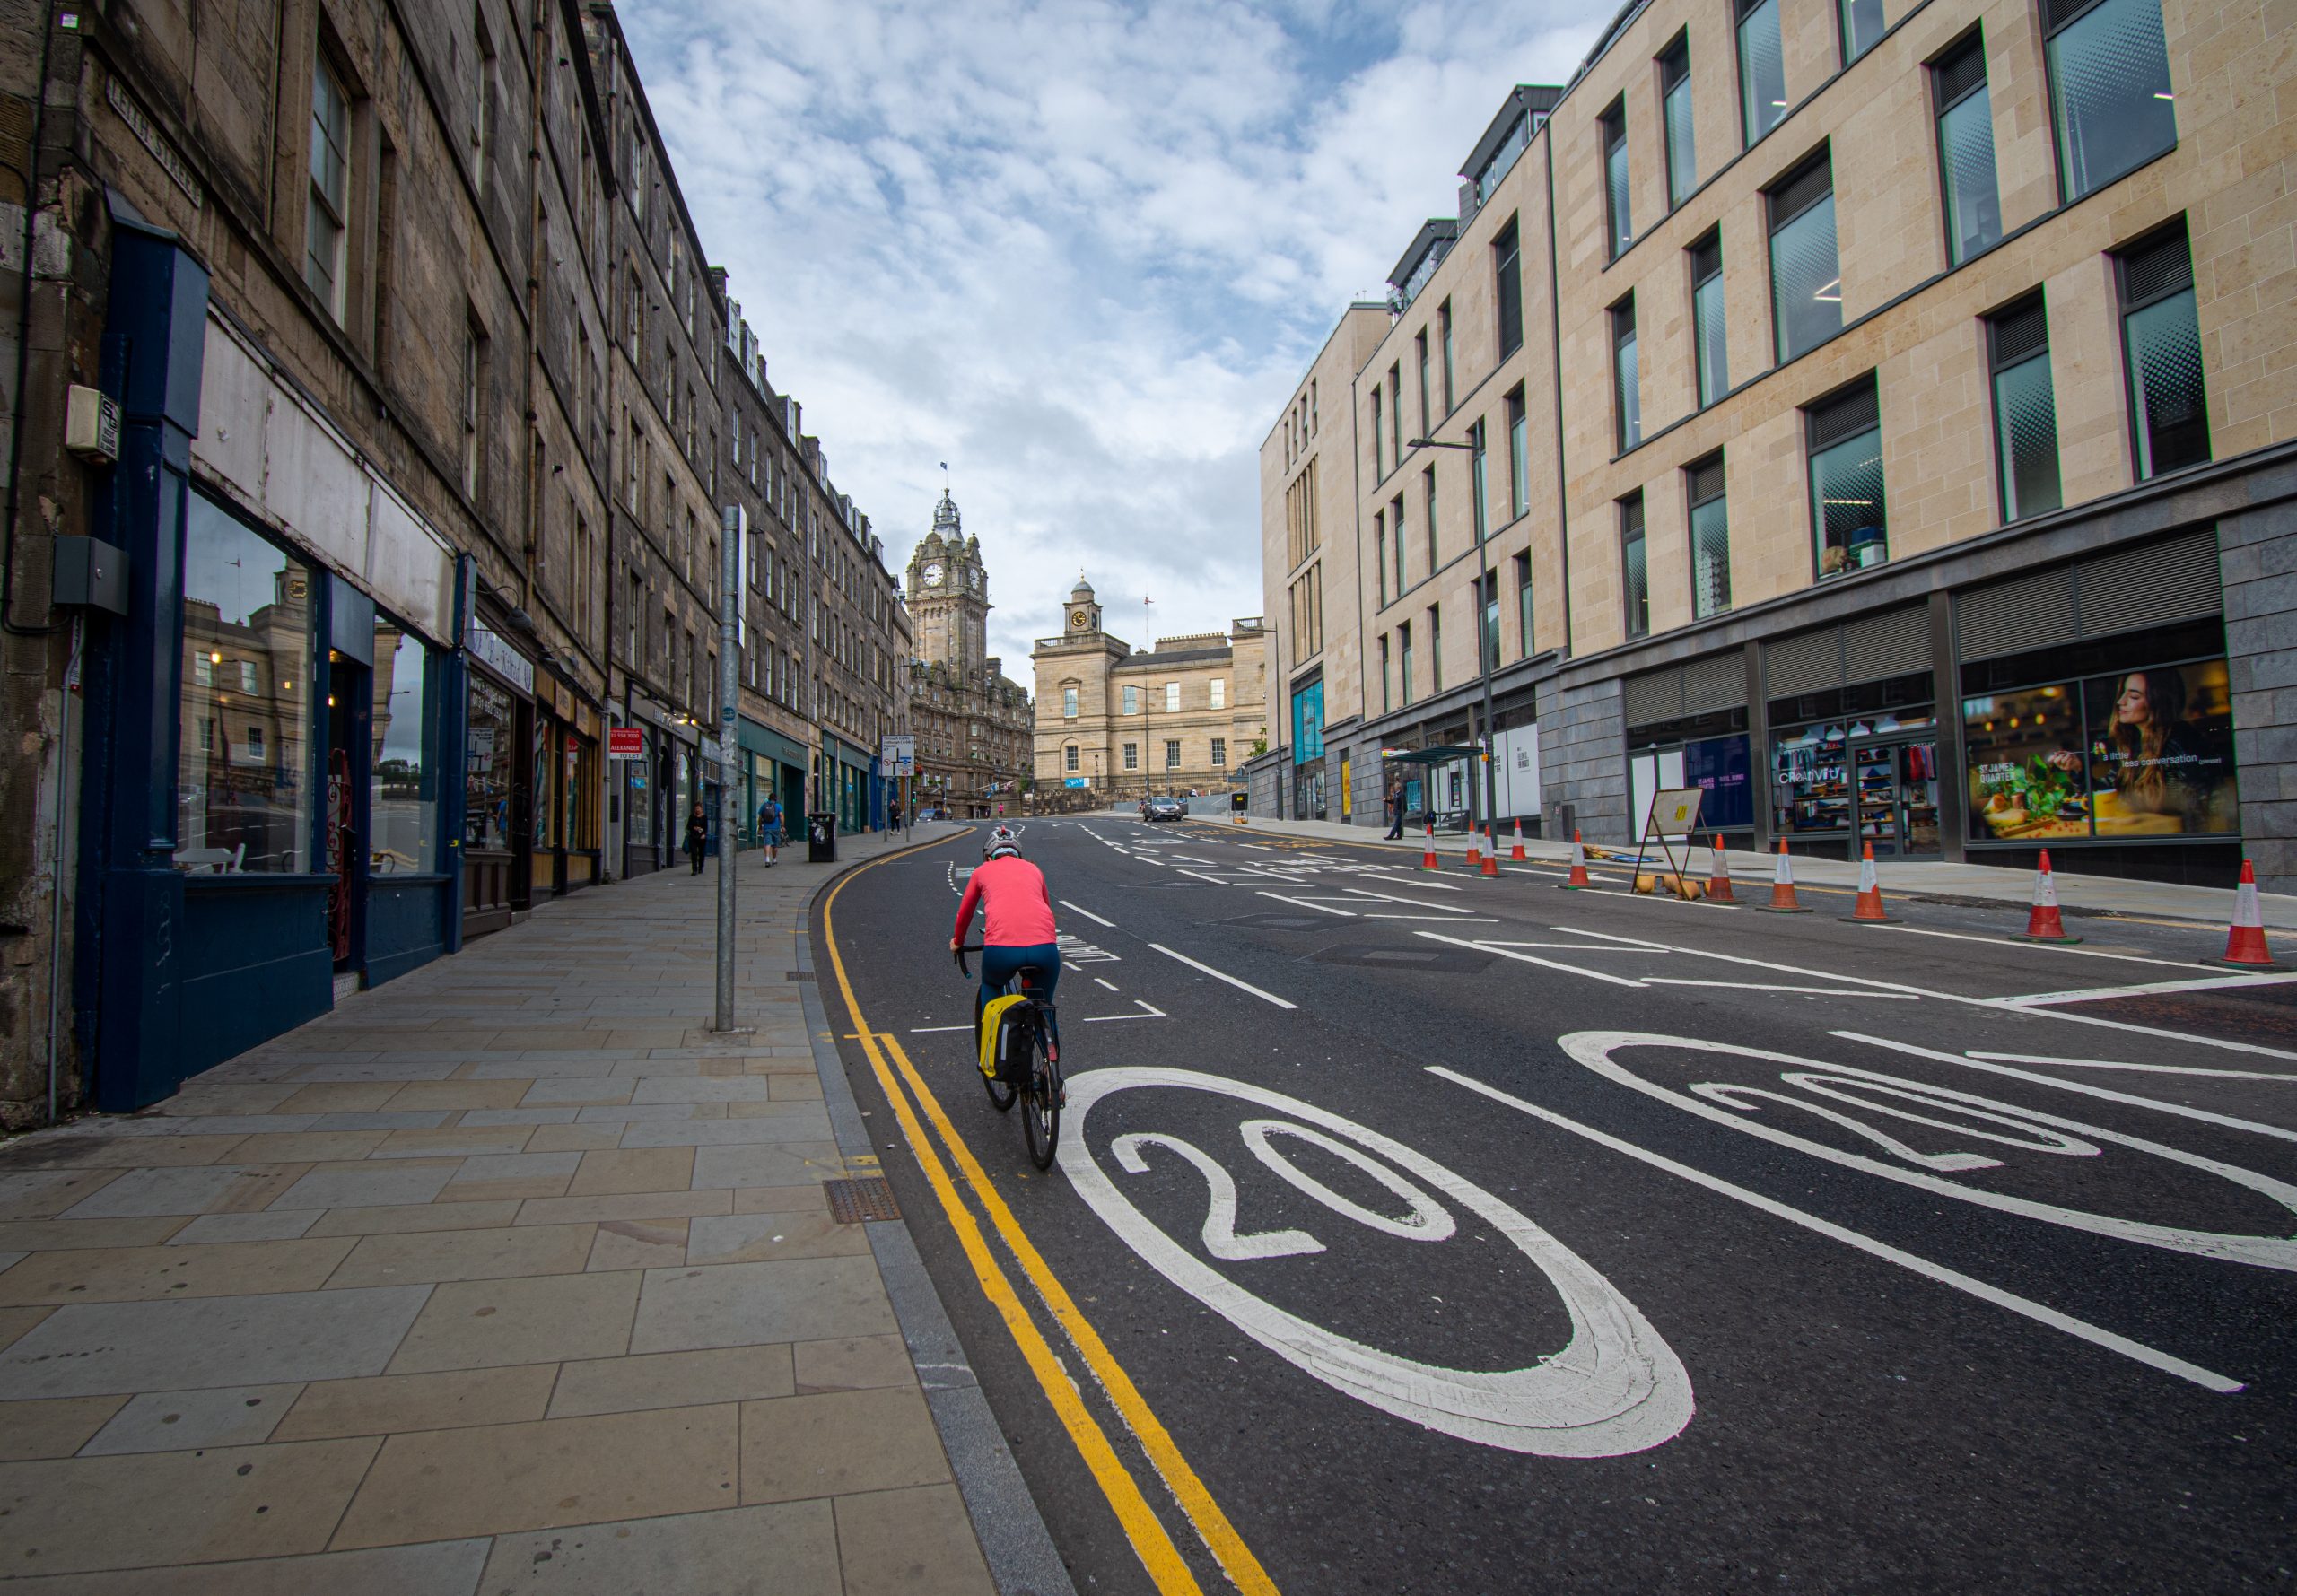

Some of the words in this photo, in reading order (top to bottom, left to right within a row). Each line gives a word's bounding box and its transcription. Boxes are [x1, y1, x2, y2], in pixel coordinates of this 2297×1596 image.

[109, 75, 148, 143] LEITH
[154, 136, 199, 204] STREET
[2109, 751, 2129, 761] little
[2121, 757, 2139, 769] less
[2140, 752, 2197, 766] conversation
[1989, 761, 2014, 773] JAMES
[1979, 771, 2016, 783] QUARTER
[1689, 1071, 2102, 1170] 20
[1111, 1119, 1456, 1261] 20
